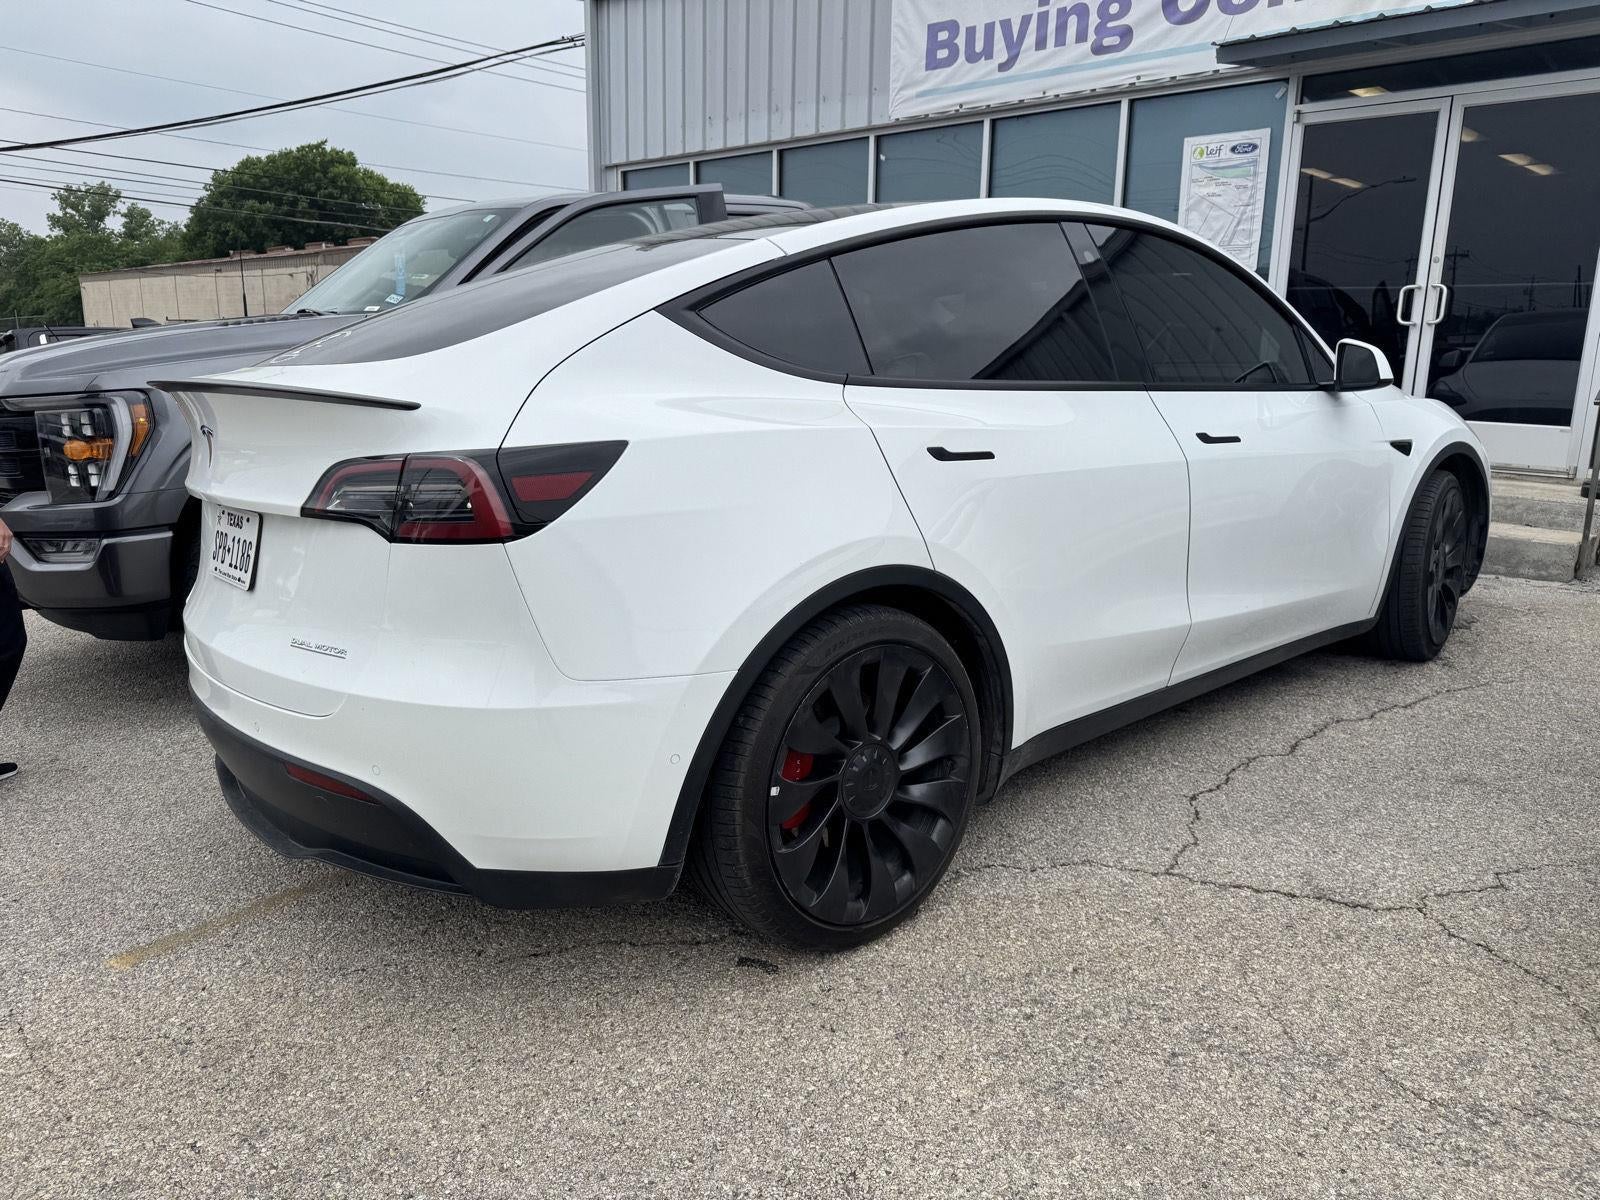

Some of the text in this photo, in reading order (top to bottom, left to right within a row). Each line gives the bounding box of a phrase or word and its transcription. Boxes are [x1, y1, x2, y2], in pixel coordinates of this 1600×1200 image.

[925, 0, 1134, 72] Buying
[227, 511, 243, 529] TEXAS
[291, 638, 347, 656] DUAL MOTOR
